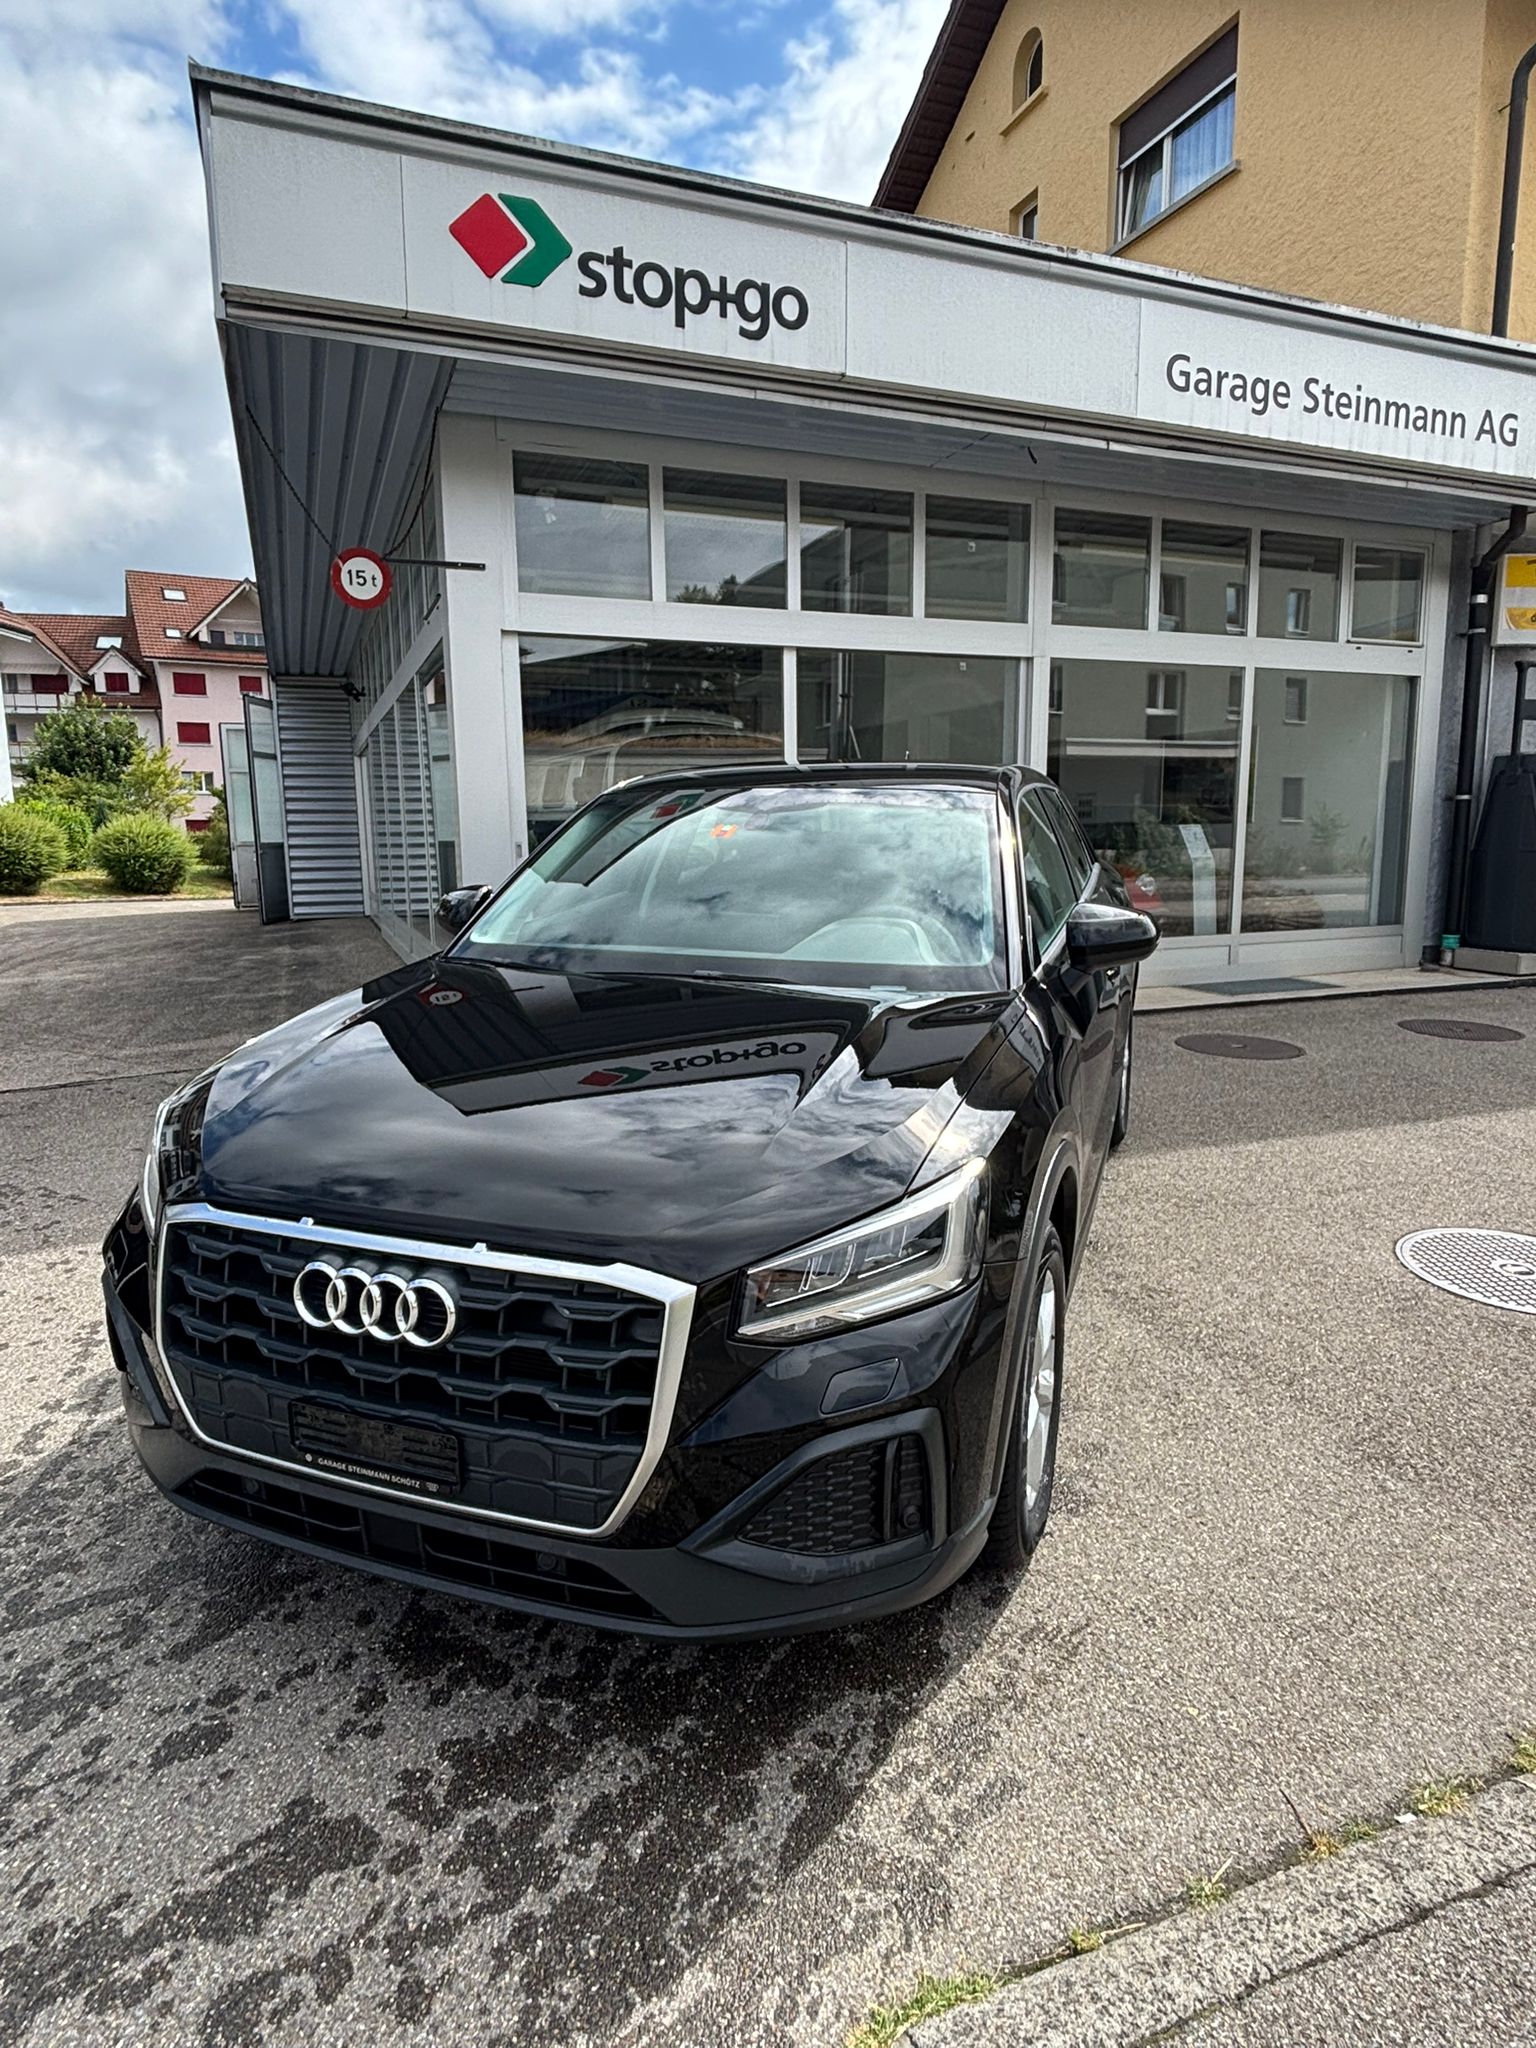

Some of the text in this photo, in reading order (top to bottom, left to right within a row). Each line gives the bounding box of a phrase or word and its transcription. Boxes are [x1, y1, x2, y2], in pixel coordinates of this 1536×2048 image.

[577, 245, 810, 341] stop+go
[1165, 353, 1519, 447] Garage Steinmann AG
[347, 569, 378, 588] 15 t
[318, 1458, 346, 1471] GARAGE
[347, 1465, 390, 1481] STEINMANN
